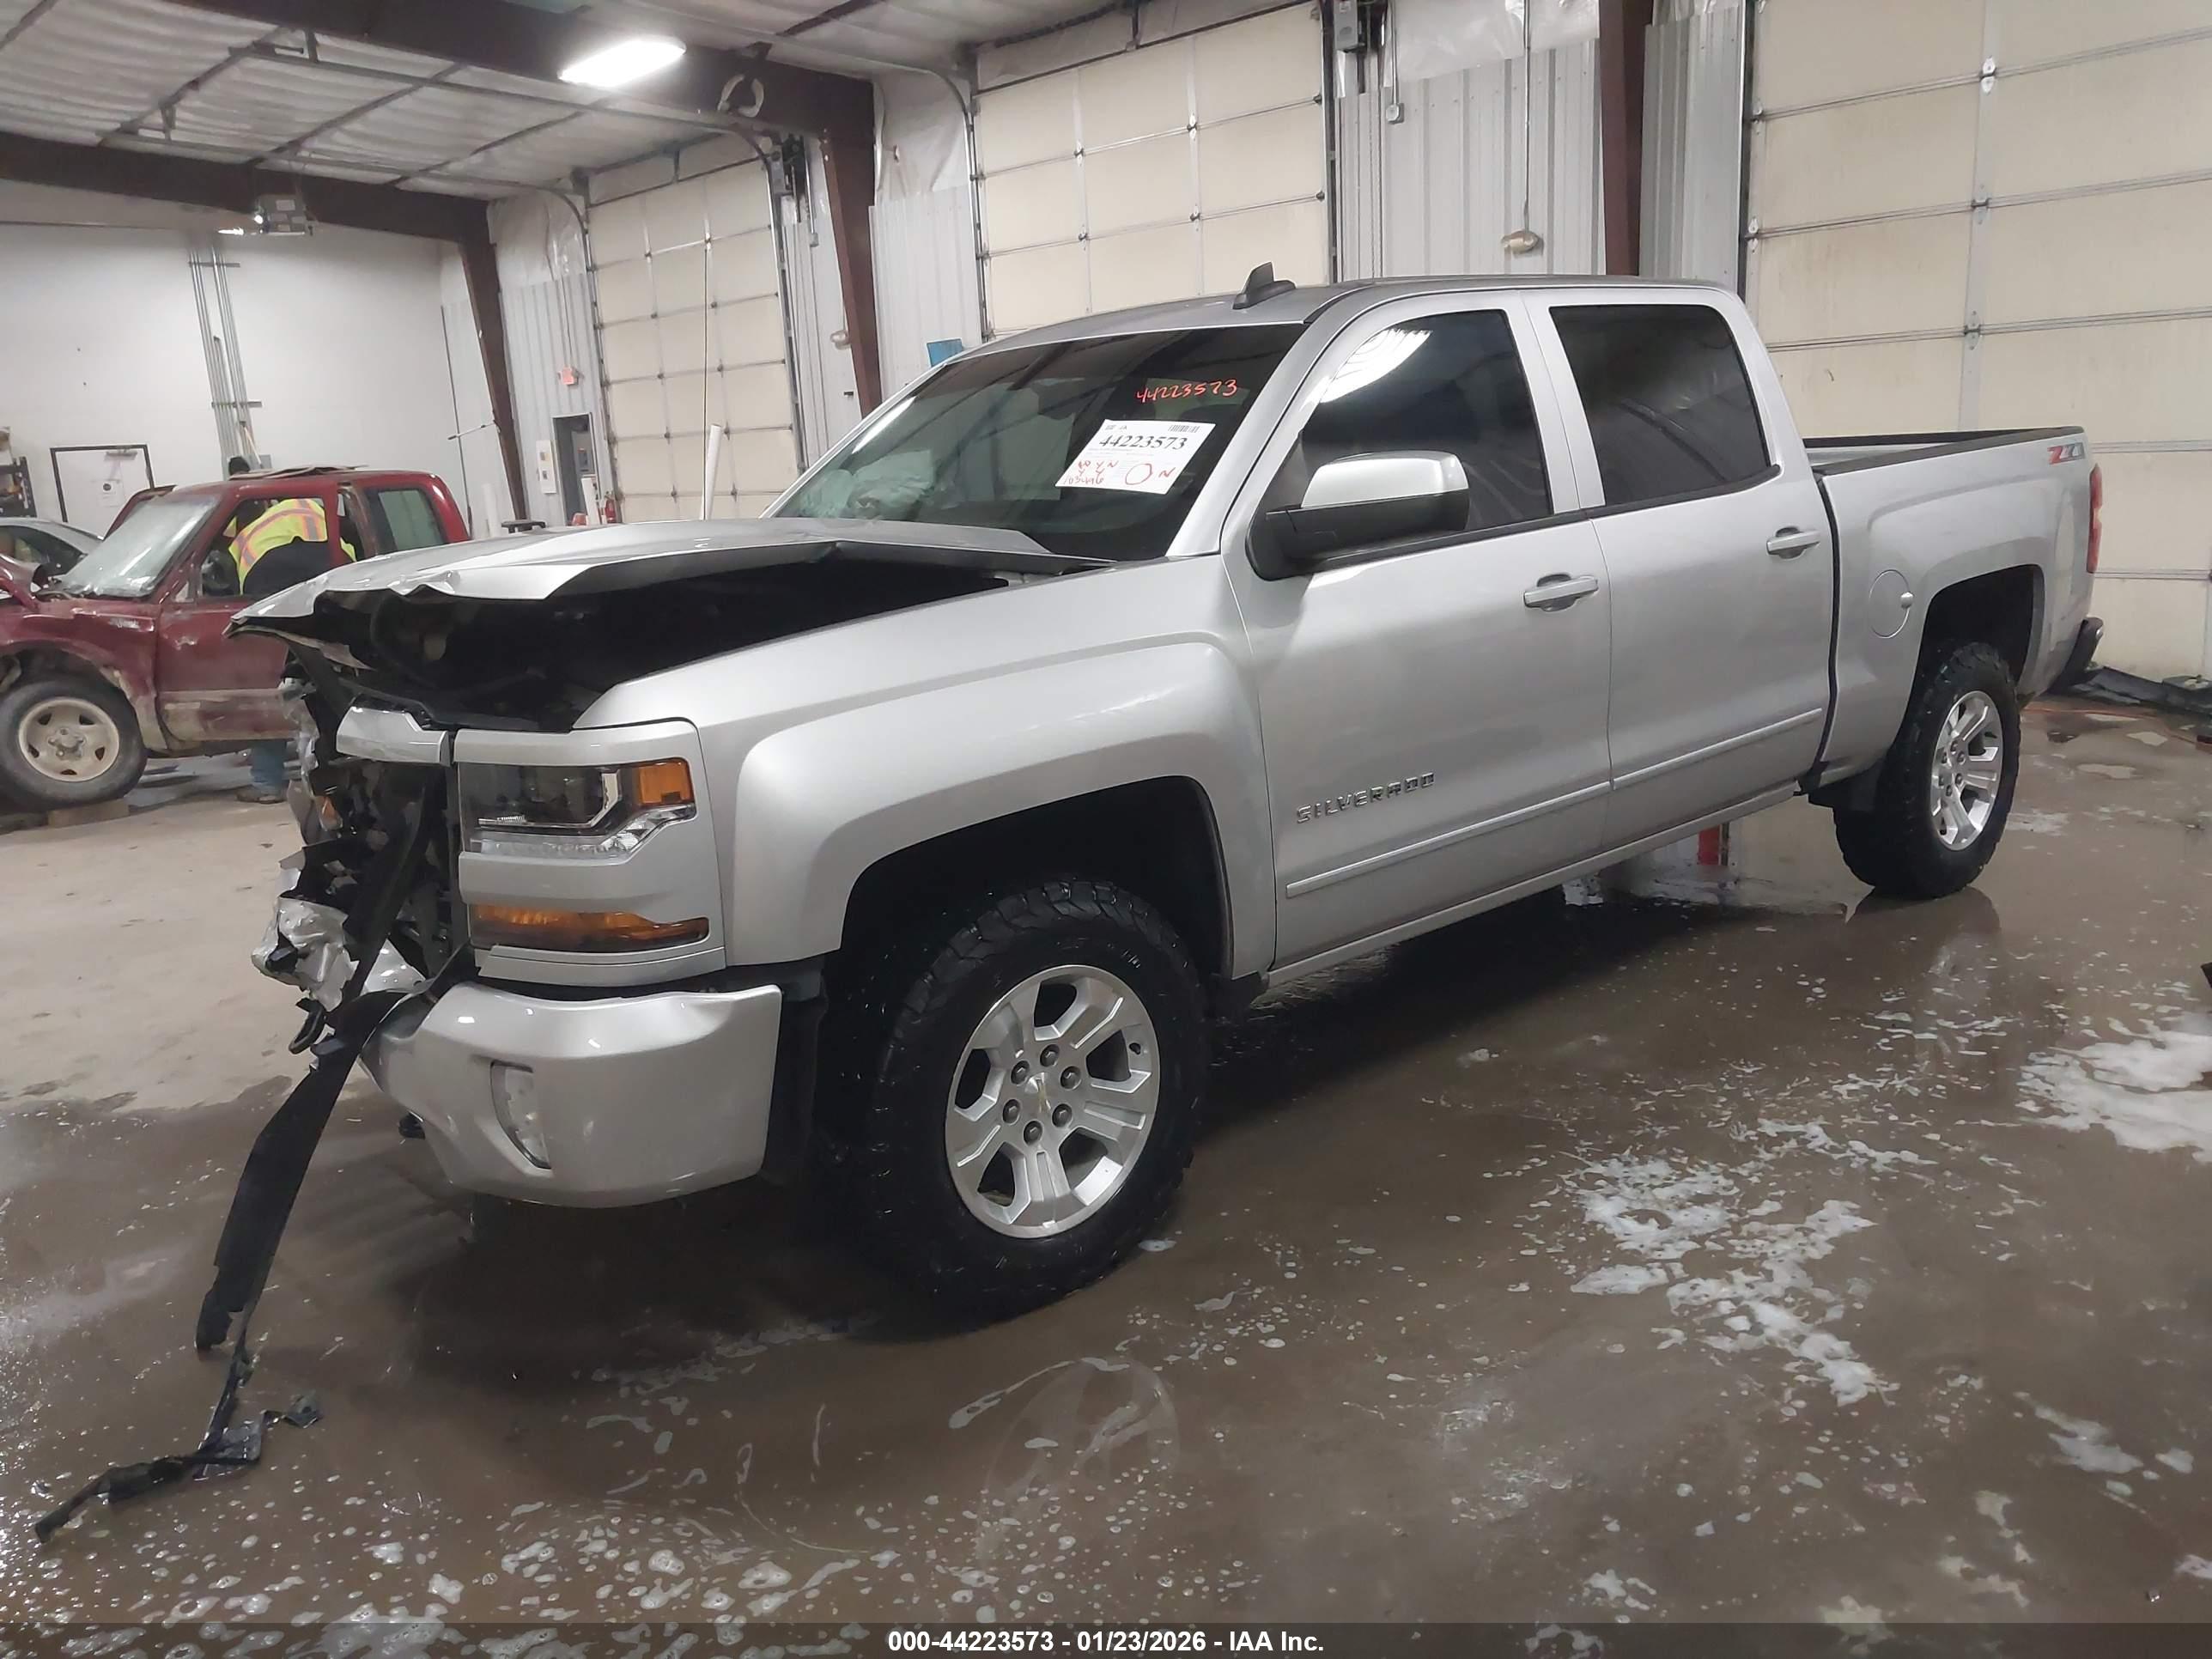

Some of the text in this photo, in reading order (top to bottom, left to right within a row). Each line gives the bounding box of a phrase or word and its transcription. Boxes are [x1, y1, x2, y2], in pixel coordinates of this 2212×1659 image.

[1136, 379, 1237, 403] 44223573
[1099, 434, 1188, 450] 44223573
[1297, 772, 1435, 823] SILVERADO
